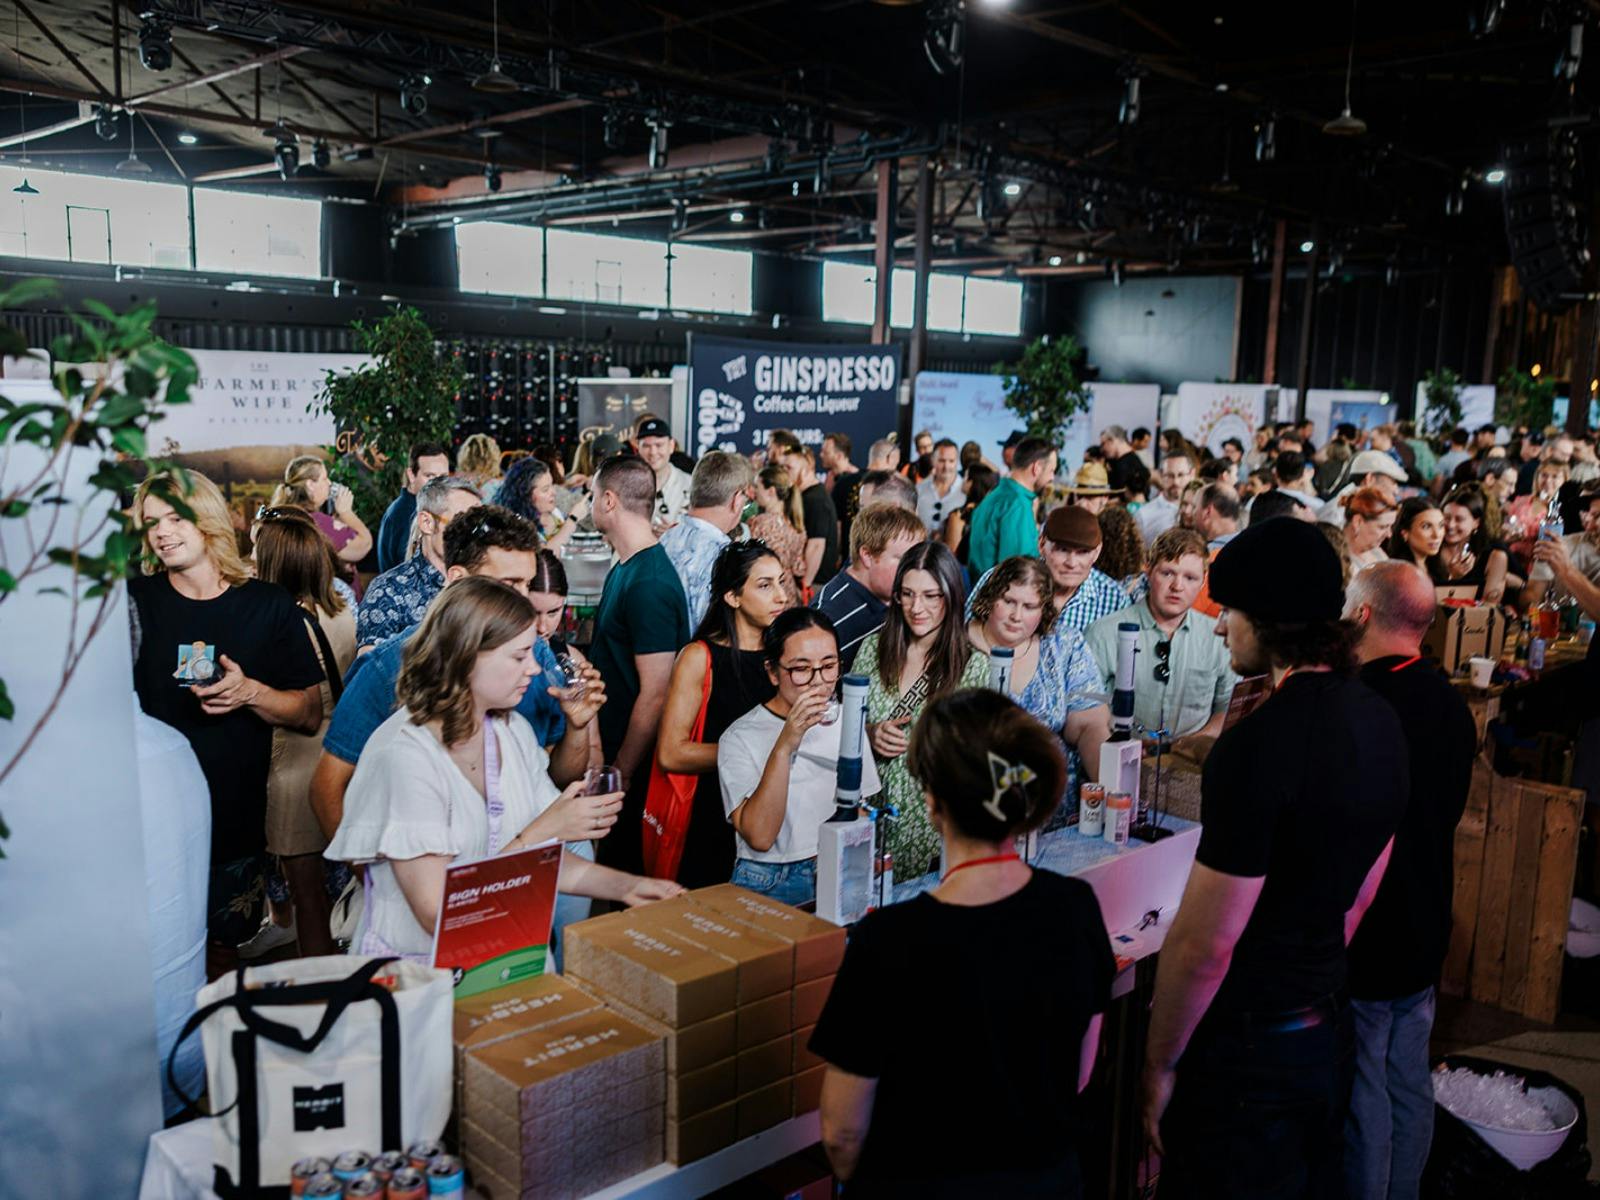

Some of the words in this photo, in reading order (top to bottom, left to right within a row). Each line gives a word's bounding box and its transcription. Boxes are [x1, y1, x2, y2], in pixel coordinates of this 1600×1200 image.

[199, 376, 323, 392] FARMER'S
[754, 355, 896, 393] GINSPRESSO
[231, 396, 293, 410] WIFE
[753, 394, 795, 413] Coffee
[795, 394, 816, 412] Gin
[816, 395, 861, 416] Liqueur
[752, 429, 761, 446] 3
[448, 886, 481, 904] SIGN
[482, 874, 532, 897] HOLDER
[736, 896, 795, 921] HERBIT
[683, 912, 741, 939] HERBIT
[623, 928, 682, 957] HERBIT
[469, 993, 563, 1028] HERBIT
[523, 1028, 620, 1068] HERBIT
